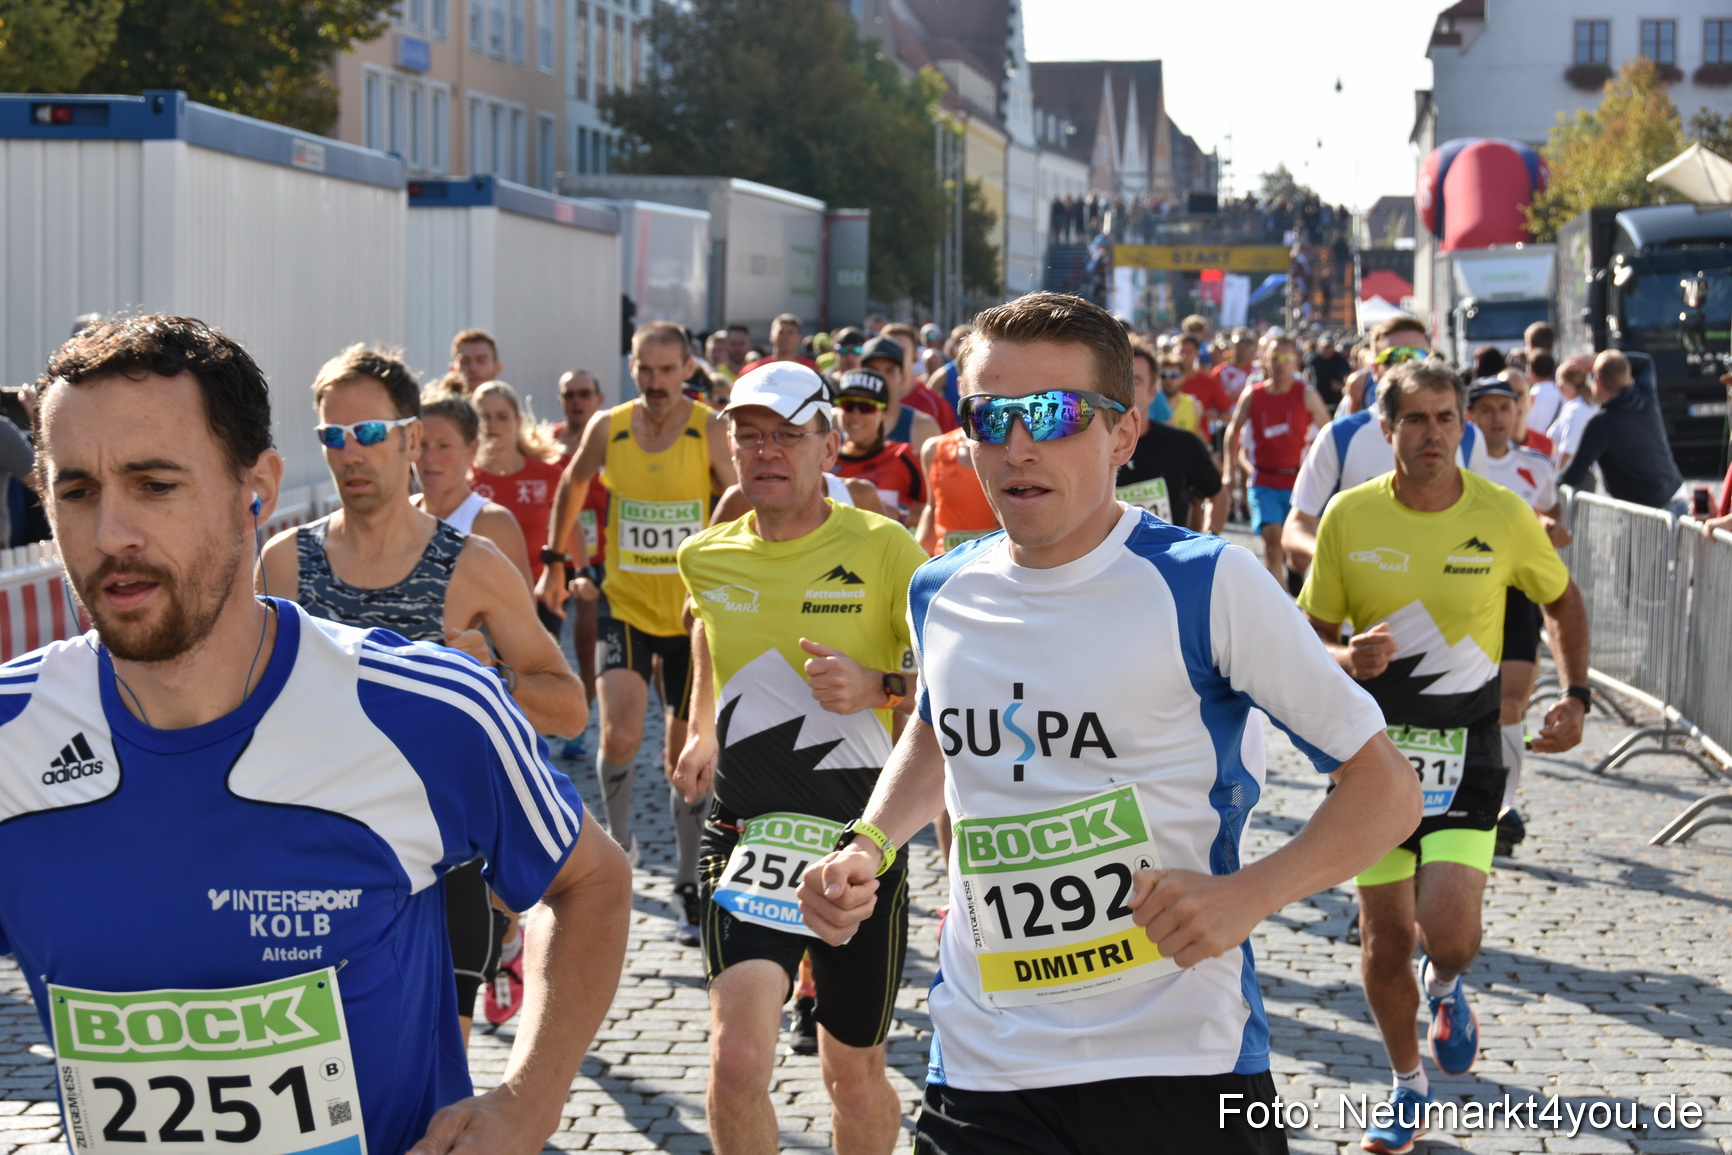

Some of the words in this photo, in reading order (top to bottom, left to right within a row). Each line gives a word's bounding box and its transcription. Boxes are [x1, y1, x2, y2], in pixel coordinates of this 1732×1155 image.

[1171, 251, 1231, 265] START
[626, 504, 691, 519] BOCK
[1378, 562, 1410, 573] MARX
[1443, 564, 1491, 575] Runners
[805, 589, 866, 599] Kettenbach
[724, 602, 760, 613] MARX
[801, 601, 863, 614] Runners
[939, 699, 1117, 765] SUSPA
[41, 760, 104, 786] adidas
[744, 817, 843, 849] BOCK
[966, 802, 1126, 865] BOCK
[1139, 858, 1150, 870] A
[232, 888, 363, 912] INTERSPORT
[983, 862, 1134, 940] 1292
[250, 913, 332, 938] KOLB
[262, 945, 323, 962] Altdorf
[1013, 938, 1134, 983] DIMITRI
[70, 990, 312, 1051] BOCK
[326, 1062, 340, 1077] B
[91, 1064, 317, 1144] 2251
